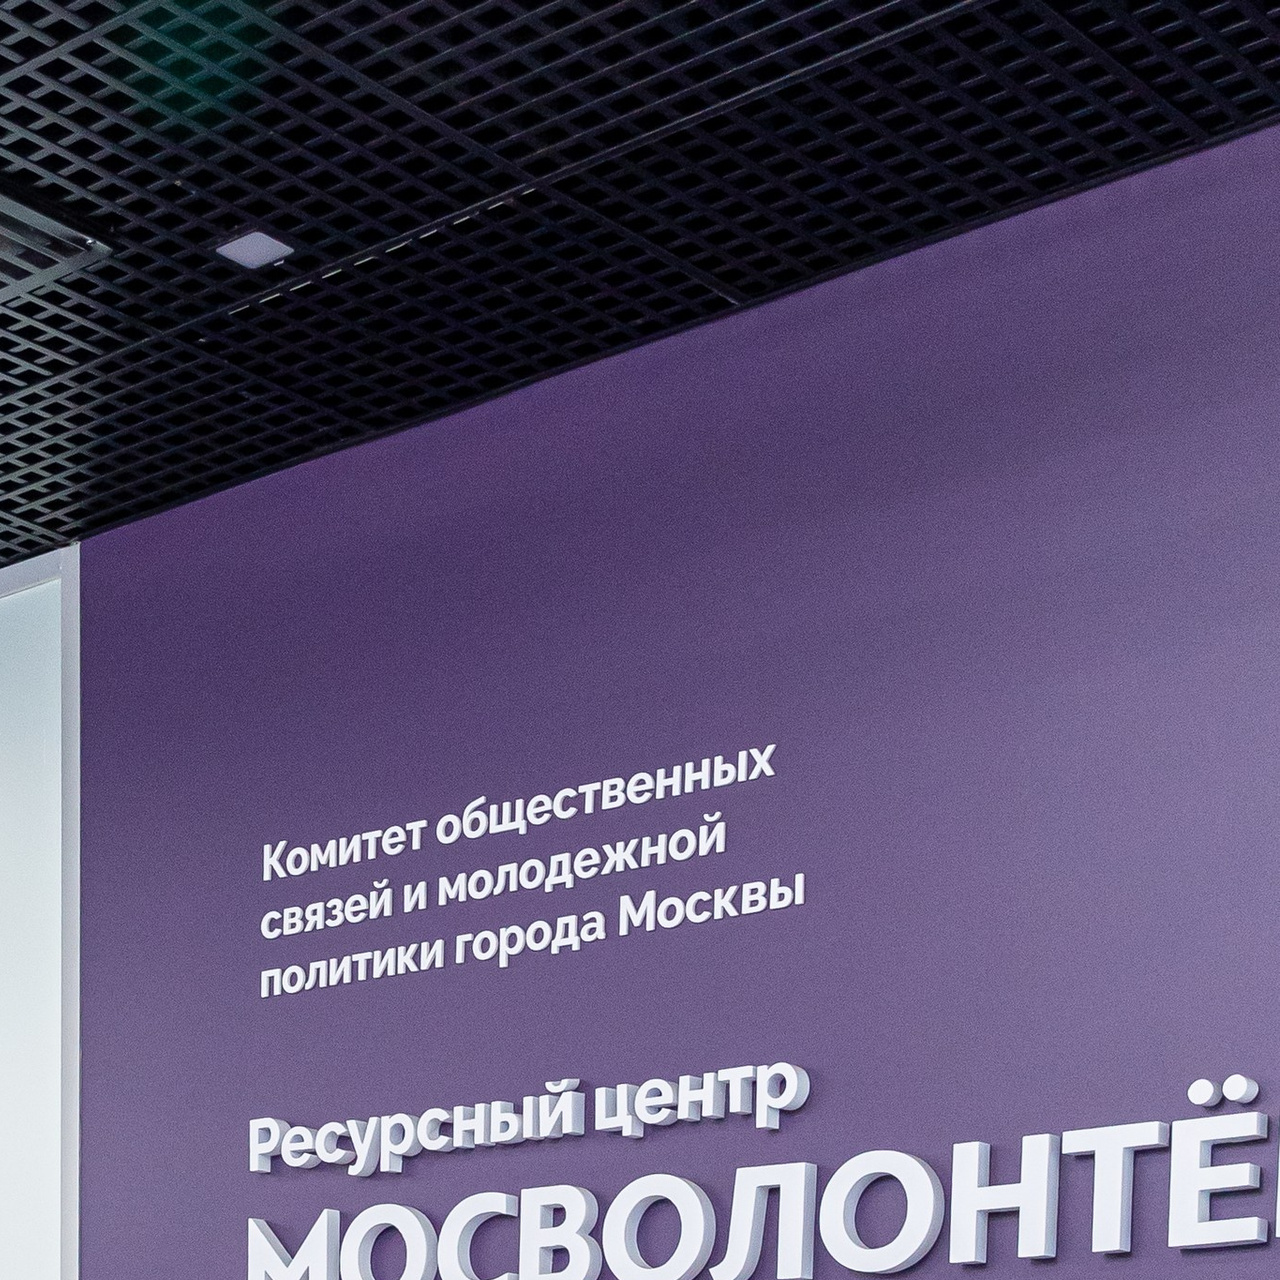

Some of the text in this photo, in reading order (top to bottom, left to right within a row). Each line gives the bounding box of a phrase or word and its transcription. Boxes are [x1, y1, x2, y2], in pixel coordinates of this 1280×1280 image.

[260, 811, 727, 941] связей и молодежной
[263, 744, 776, 881] Комитет общественных
[260, 873, 806, 998] политики города Москвы
[249, 1062, 811, 1177] Ресурсный центр
